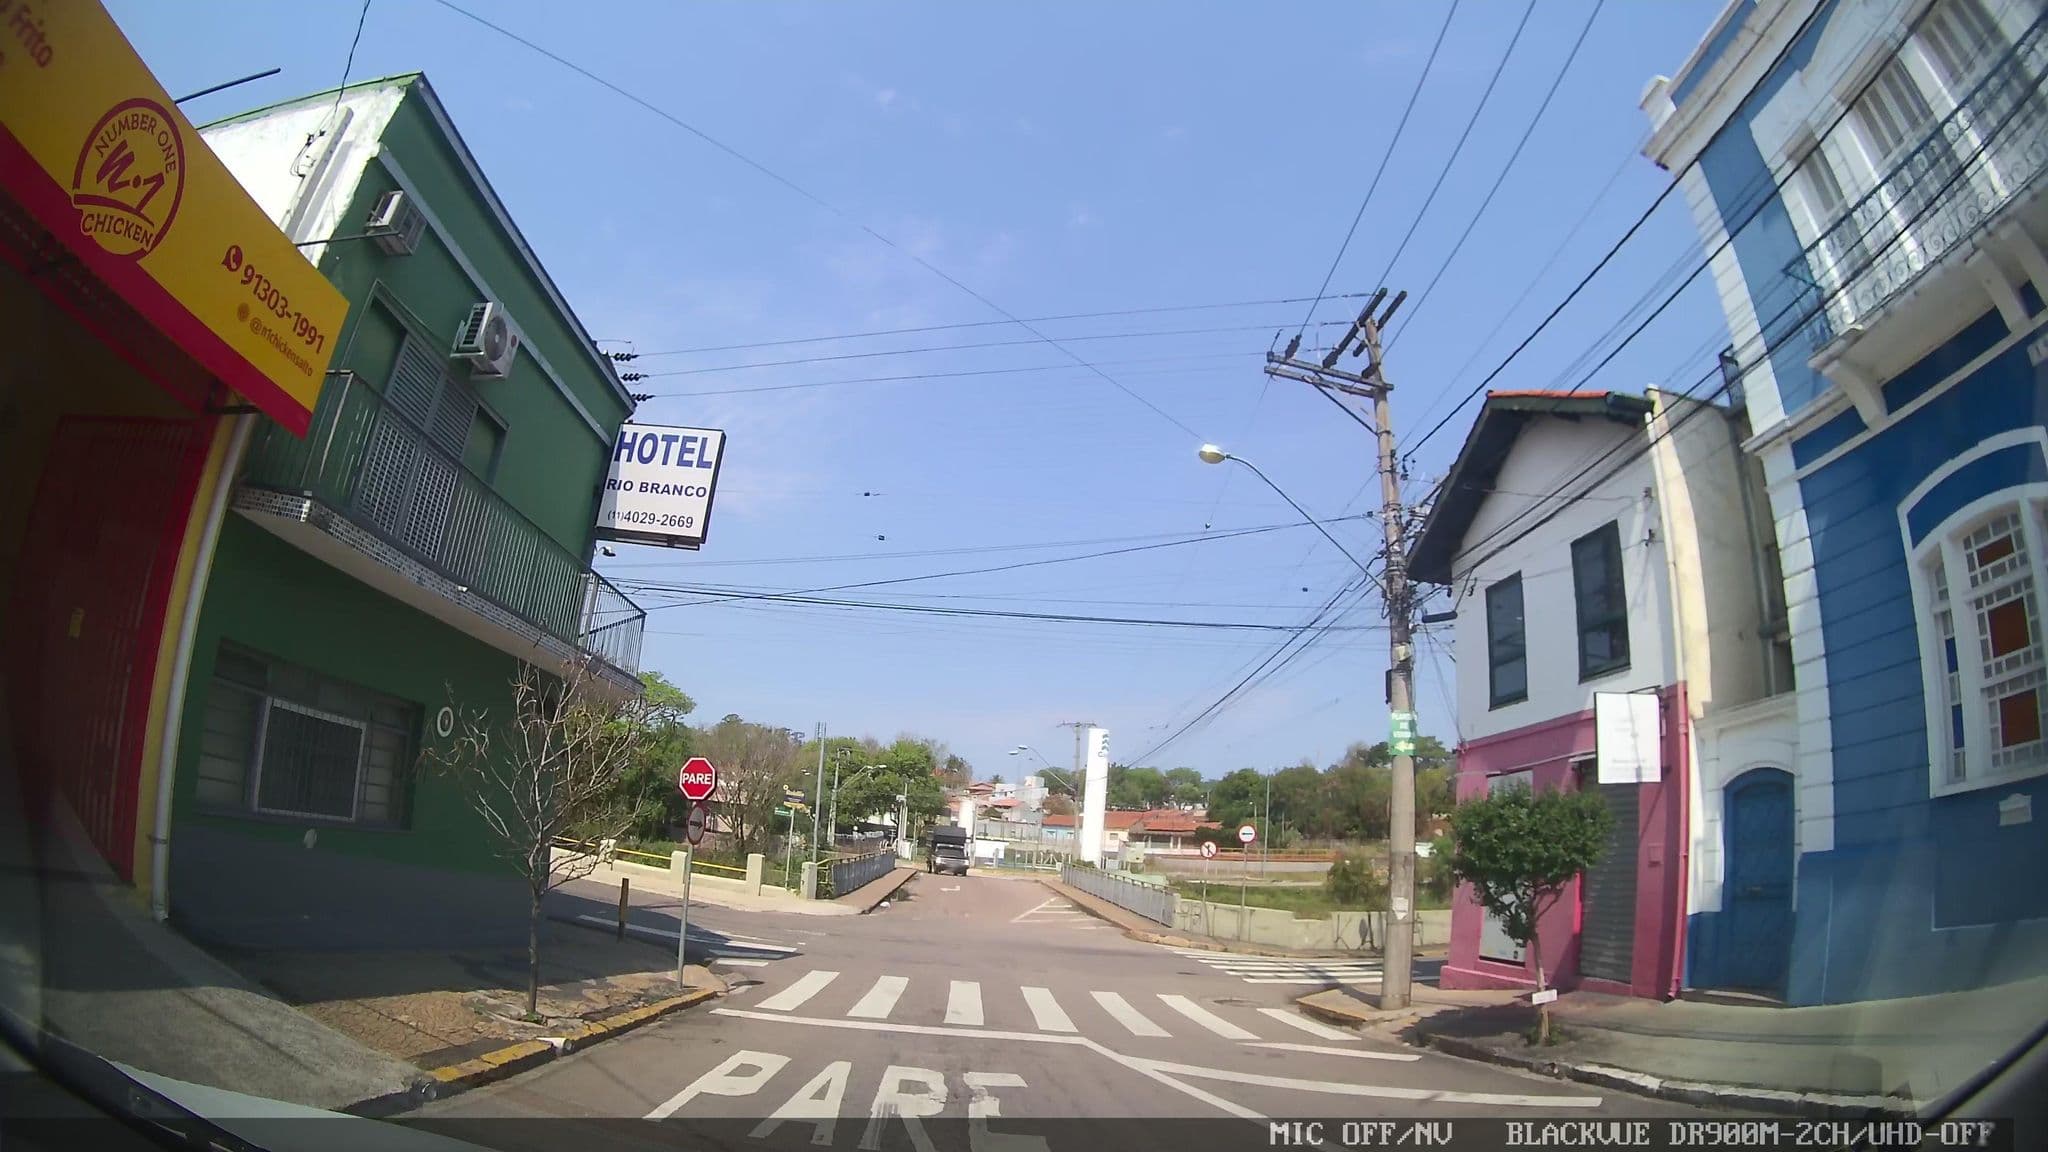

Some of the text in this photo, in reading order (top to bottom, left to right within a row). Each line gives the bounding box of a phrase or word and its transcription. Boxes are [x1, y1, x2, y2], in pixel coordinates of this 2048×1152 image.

[8, 3, 54, 69] Frito
[95, 113, 176, 175] NUMBER ONE
[82, 213, 155, 248] CHICKEN
[240, 264, 325, 354] 91303-1991
[614, 431, 713, 469] HOTEL
[606, 478, 708, 498] RIO BRANCO
[682, 773, 712, 785] PARE
[642, 1049, 1048, 1152] PARE
